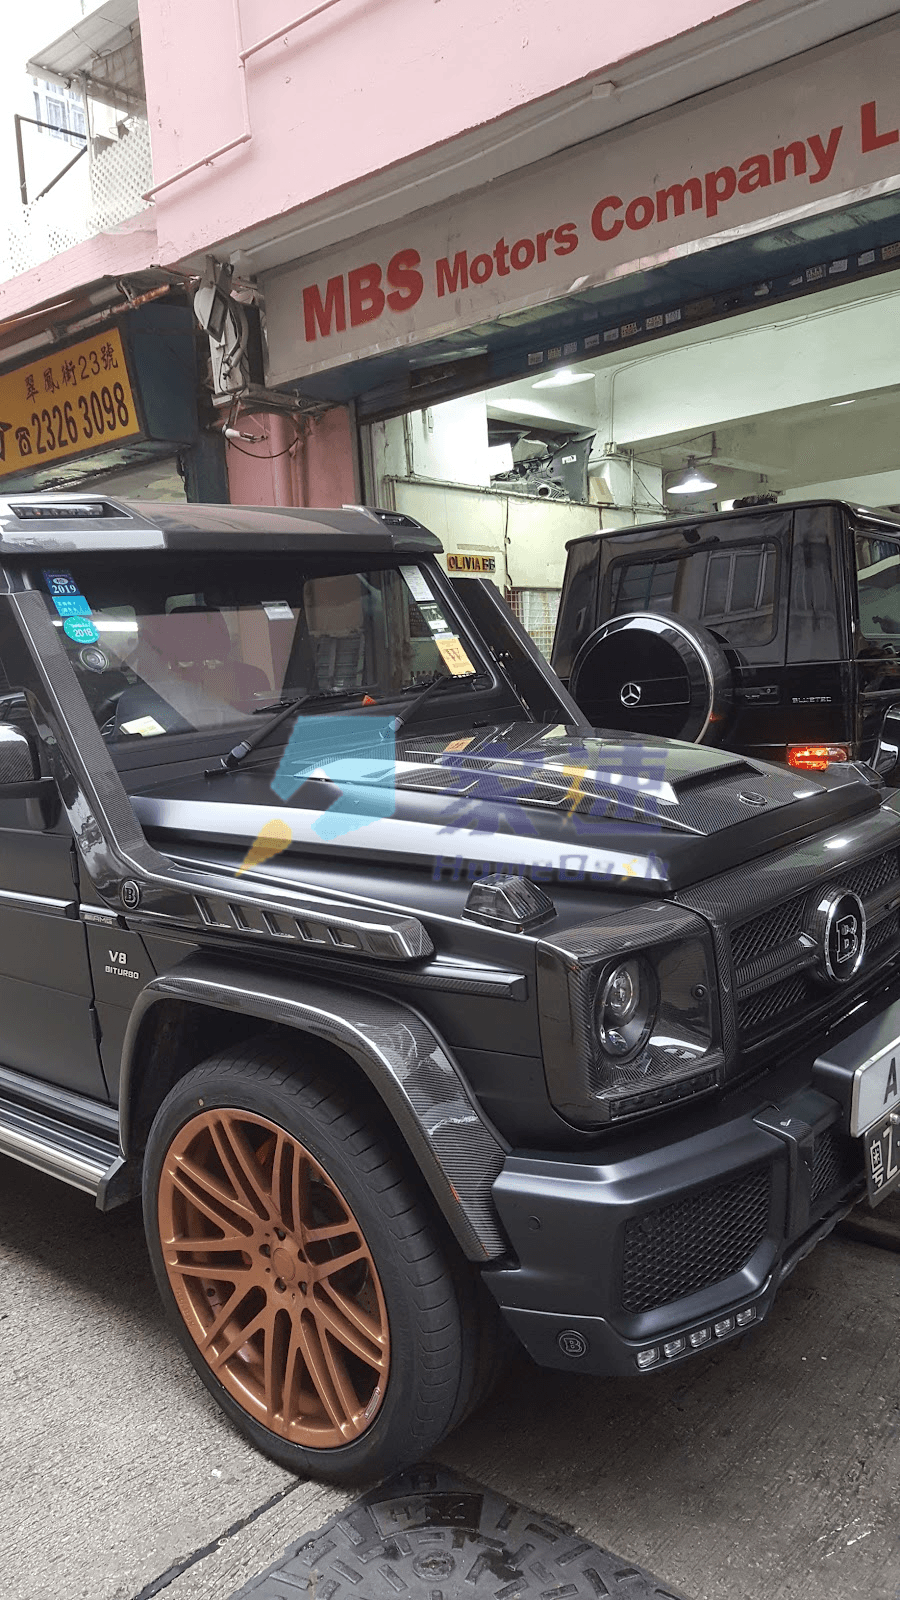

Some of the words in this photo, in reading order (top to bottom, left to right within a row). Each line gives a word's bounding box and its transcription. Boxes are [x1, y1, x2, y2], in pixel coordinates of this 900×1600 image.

[302, 248, 424, 342] MBS
[436, 222, 579, 298] Motors
[591, 125, 843, 242] Company
[24, 342, 119, 404] 翠鳳街23號
[31, 400, 78, 455] 2326
[78, 381, 129, 439] 3098
[52, 584, 76, 594] 2019
[109, 949, 127, 965] V8
[835, 914, 859, 964] B
[105, 965, 140, 980] BITURBO
